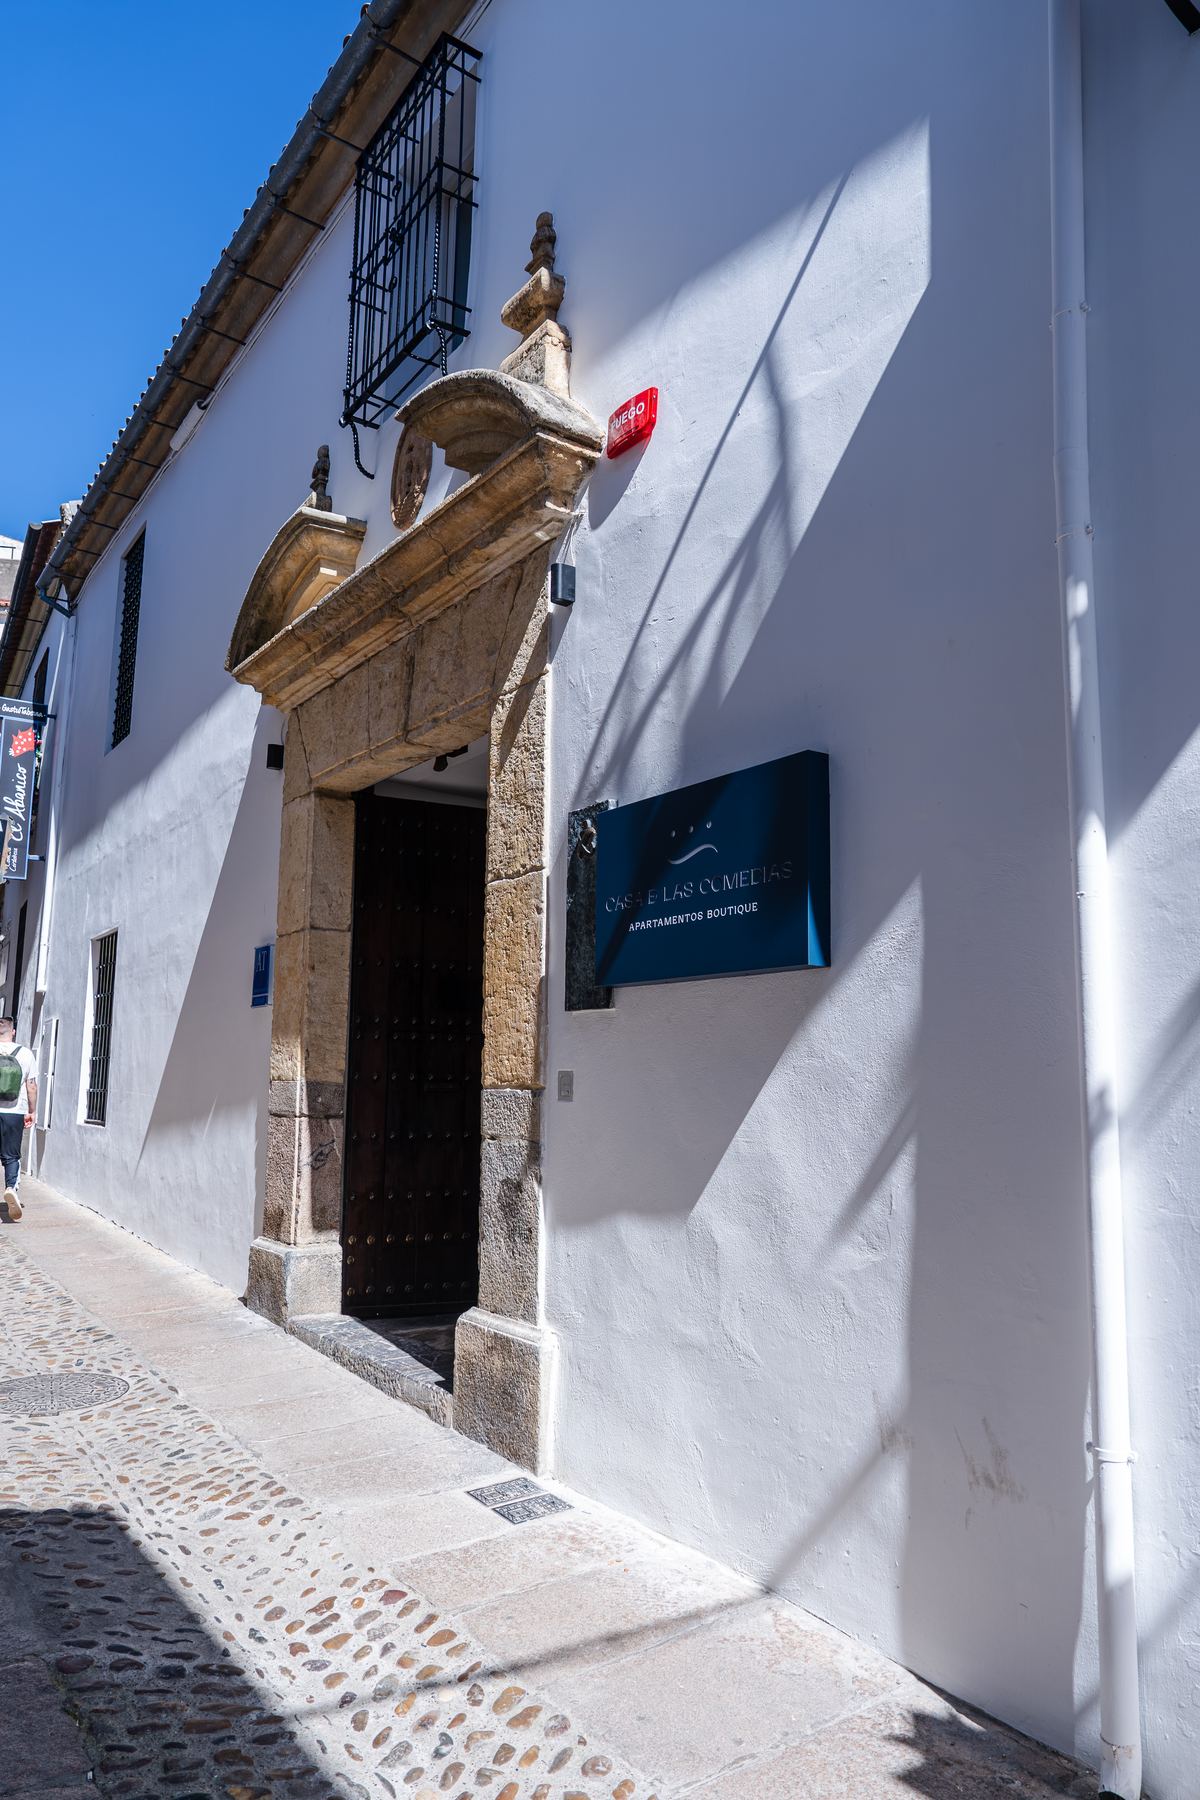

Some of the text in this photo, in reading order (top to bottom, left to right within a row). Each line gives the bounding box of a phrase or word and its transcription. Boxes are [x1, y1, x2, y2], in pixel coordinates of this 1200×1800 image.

[611, 402, 645, 429] FUEGO
[3, 763, 27, 821] Abanico
[663, 881, 693, 902] LAS
[699, 861, 793, 895] COMEDIAS
[628, 902, 759, 932] APARTAMENTOS BOUTIQUE
